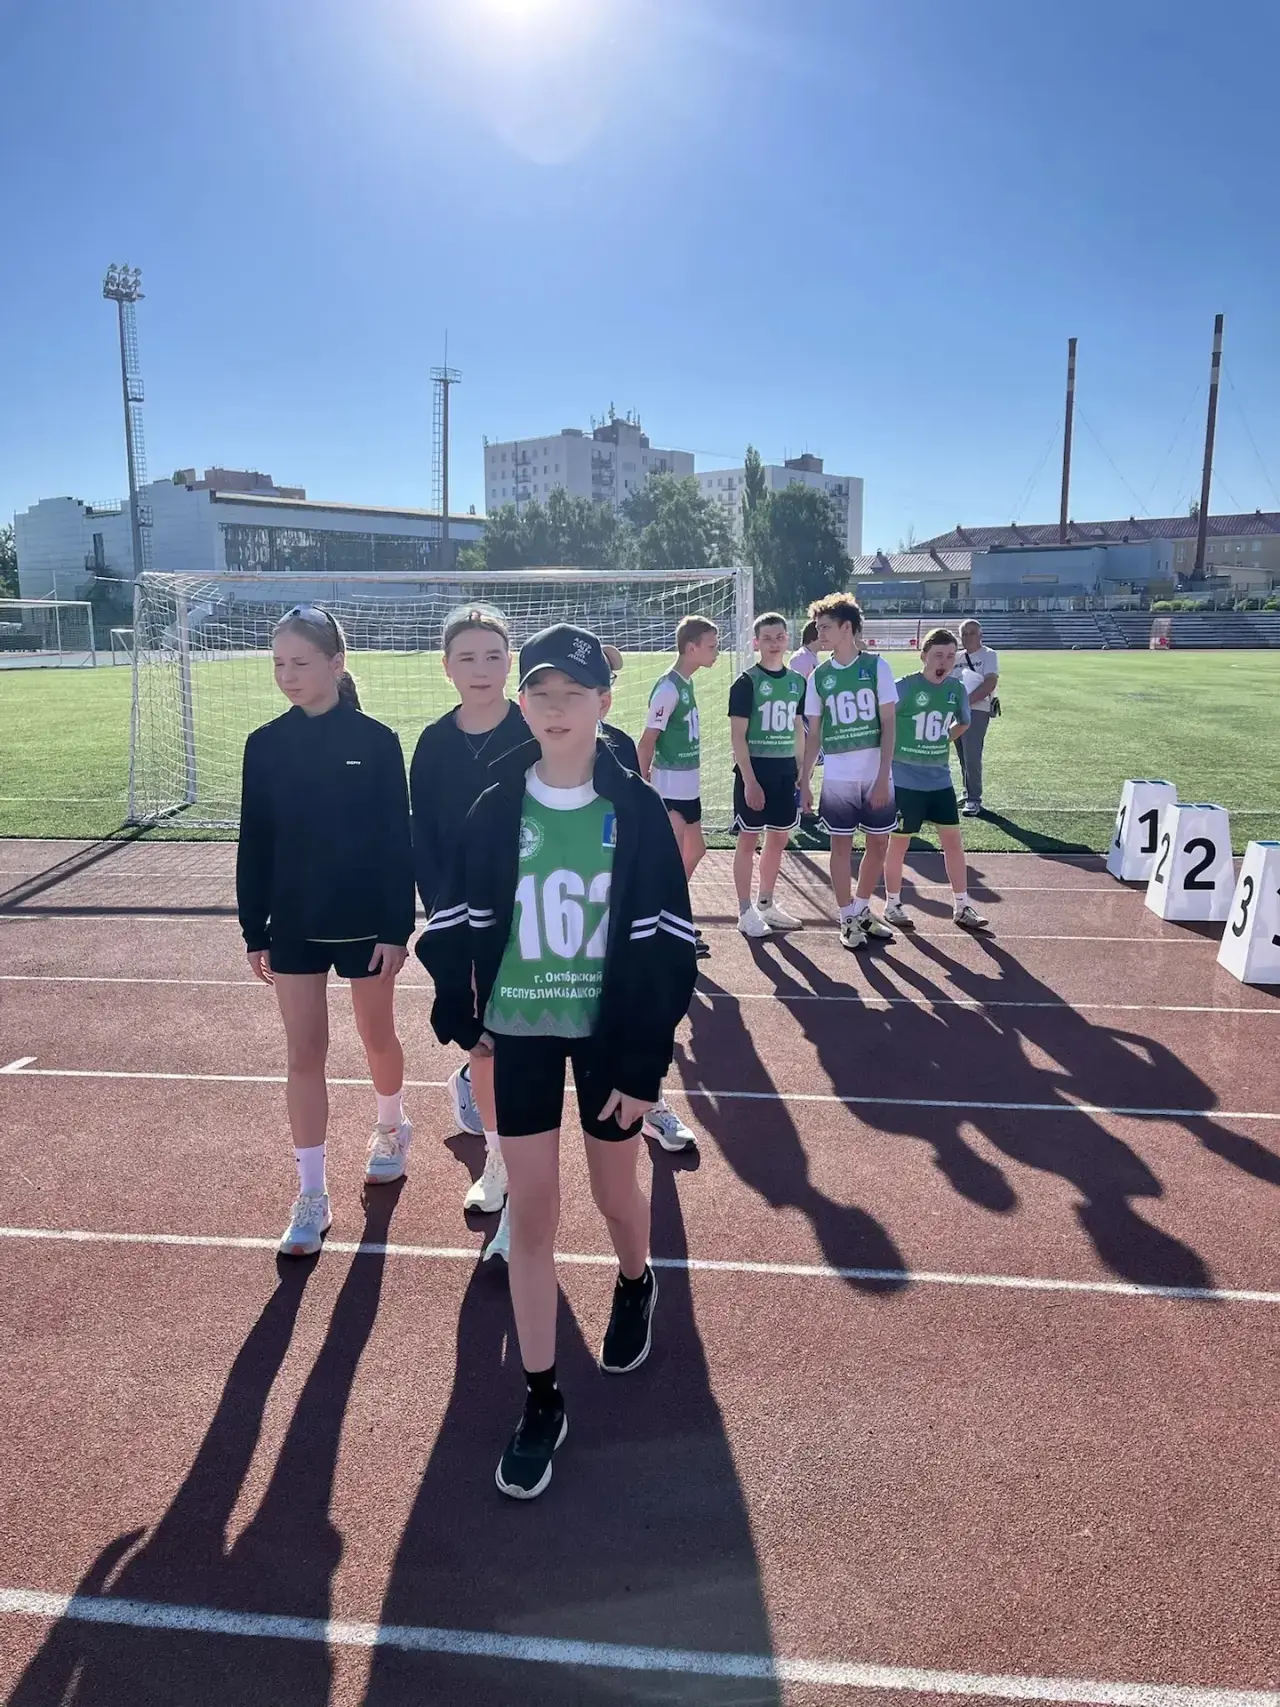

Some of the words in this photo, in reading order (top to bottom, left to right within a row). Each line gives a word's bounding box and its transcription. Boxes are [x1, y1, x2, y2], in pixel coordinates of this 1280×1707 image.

[825, 688, 876, 726] 169
[1137, 809, 1158, 853] 1
[1155, 833, 1170, 884] 2
[1183, 838, 1216, 890] 2
[1232, 875, 1253, 937] 3
